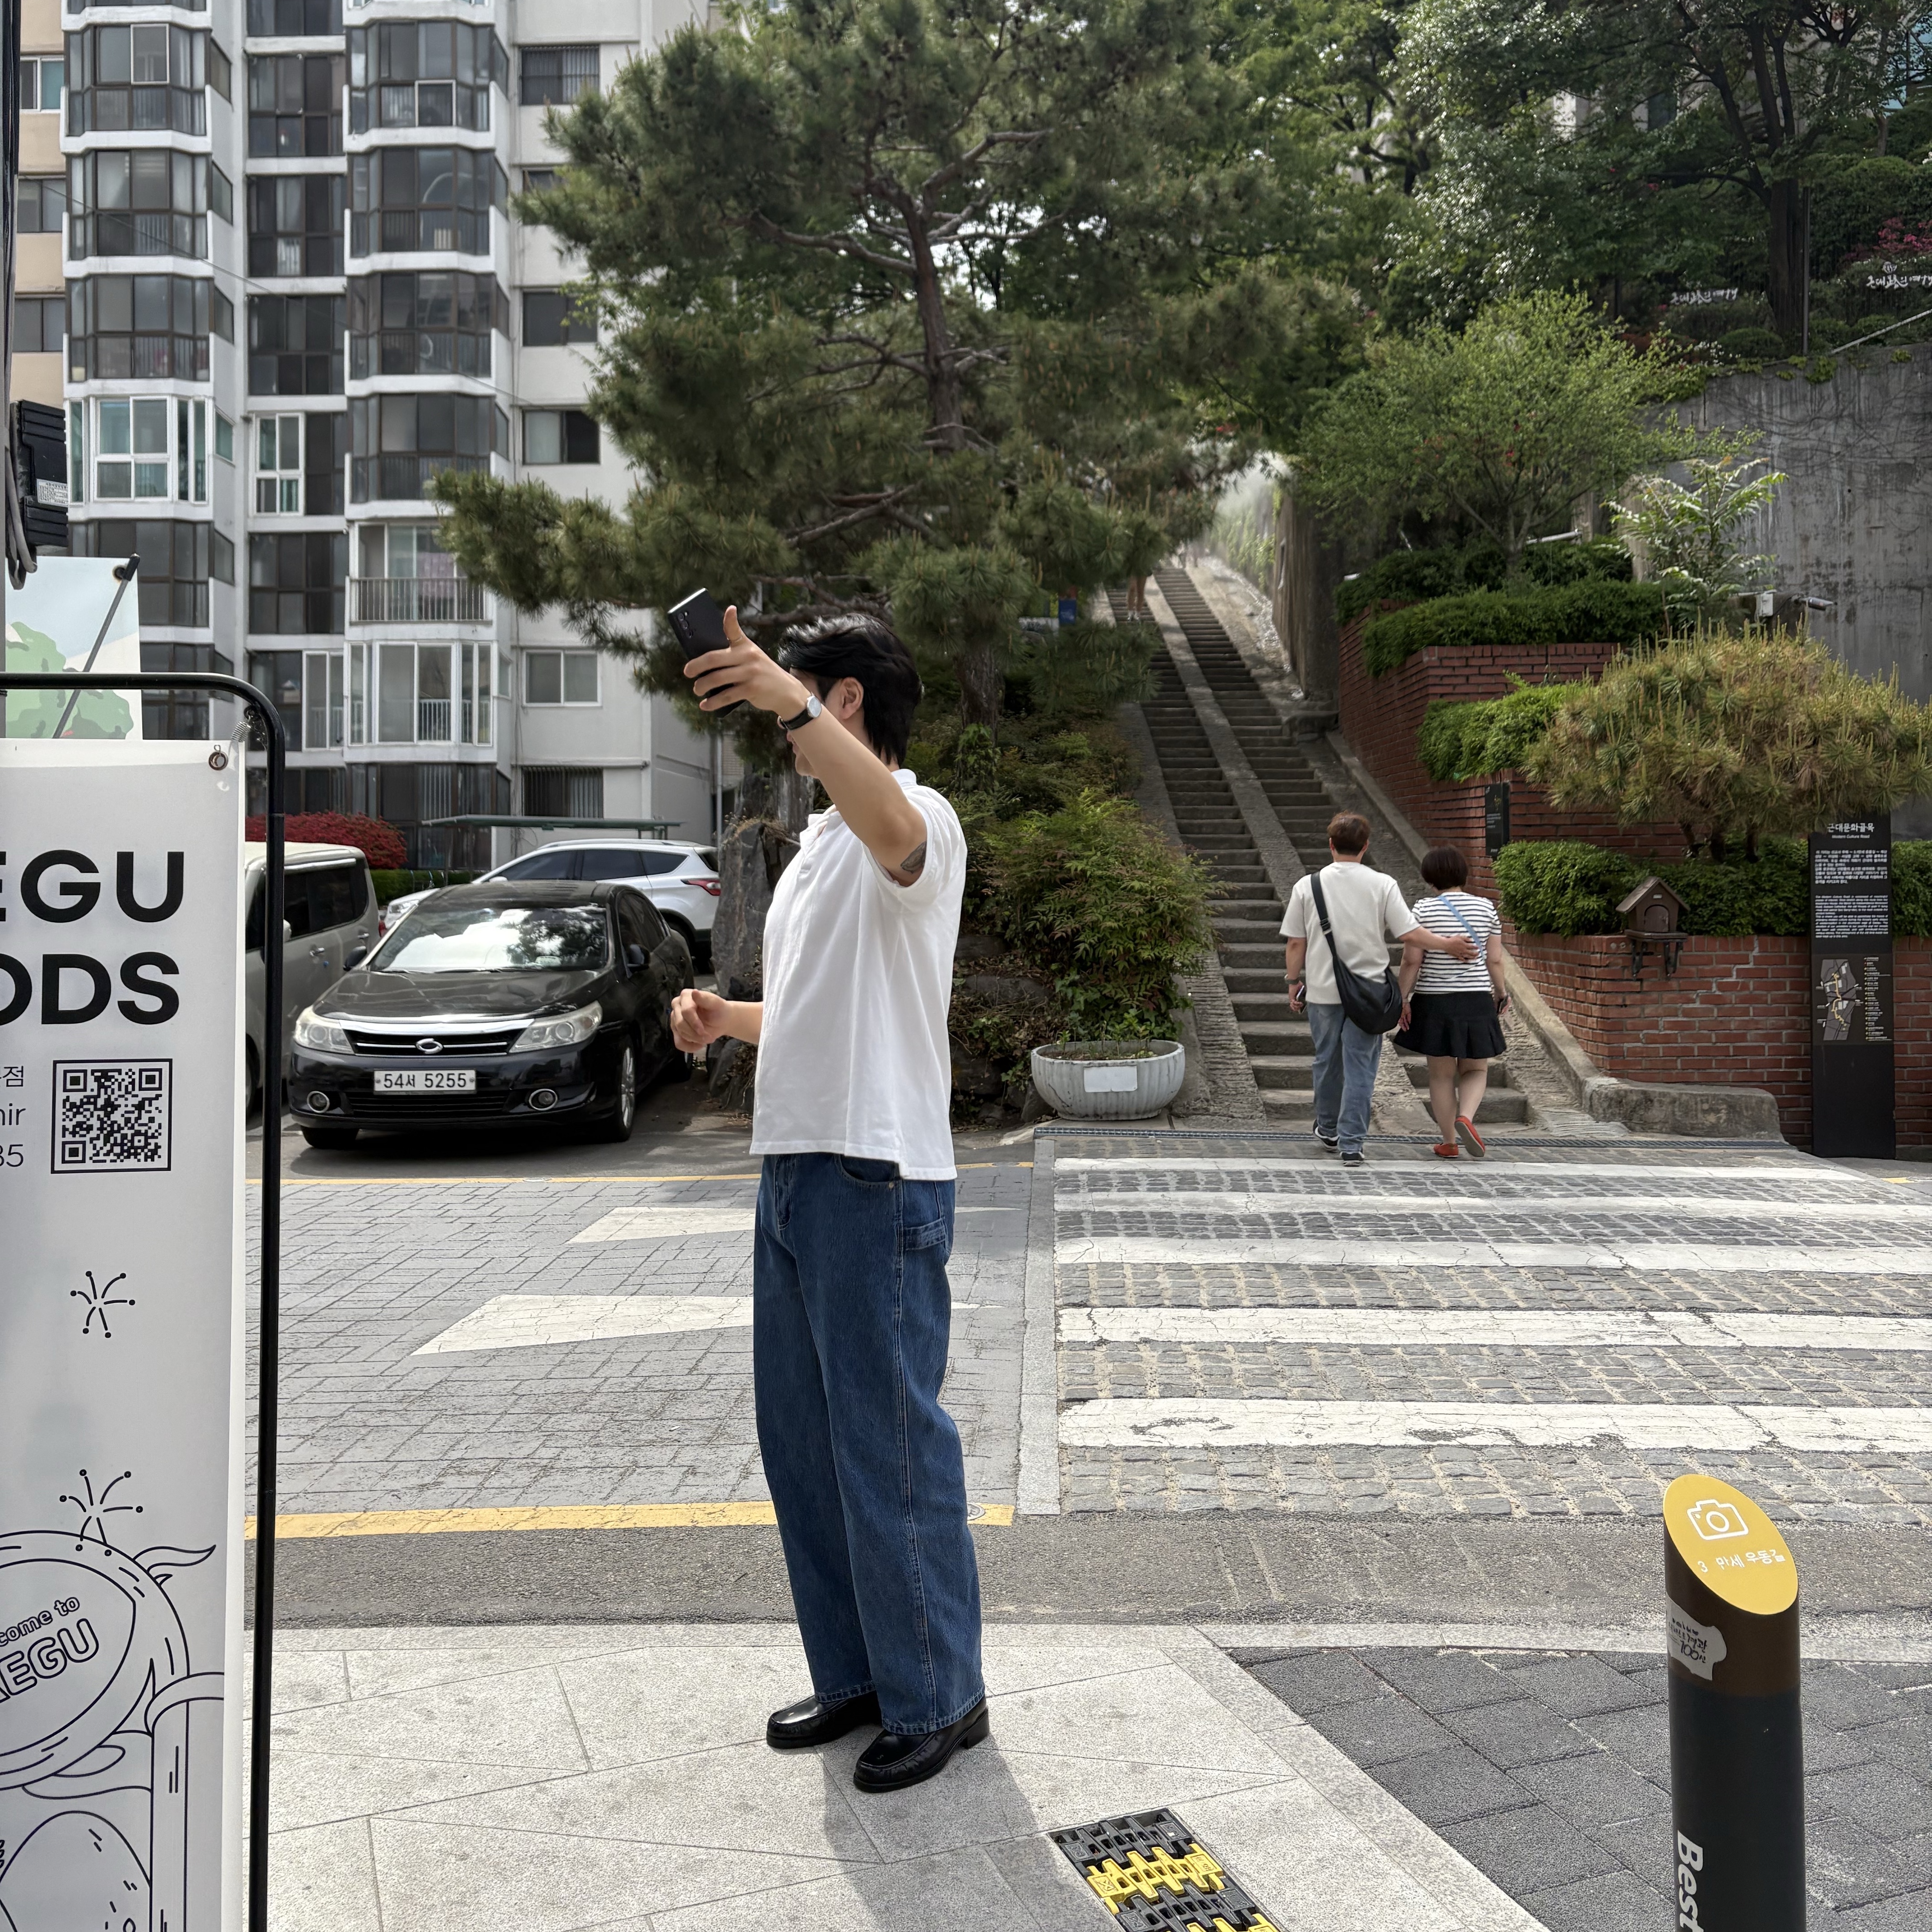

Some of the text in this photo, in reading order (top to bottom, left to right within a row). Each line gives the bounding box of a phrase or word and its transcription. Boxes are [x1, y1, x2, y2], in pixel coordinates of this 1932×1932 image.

[0, 849, 184, 923] GU
[0, 1065, 24, 1087] 점
[383, 1072, 466, 1088] 54서 5255
[1697, 1560, 1708, 1573] 3
[54, 1596, 80, 1617] to
[0, 1618, 99, 1704] EGU
[1677, 1829, 1704, 1932] Best
